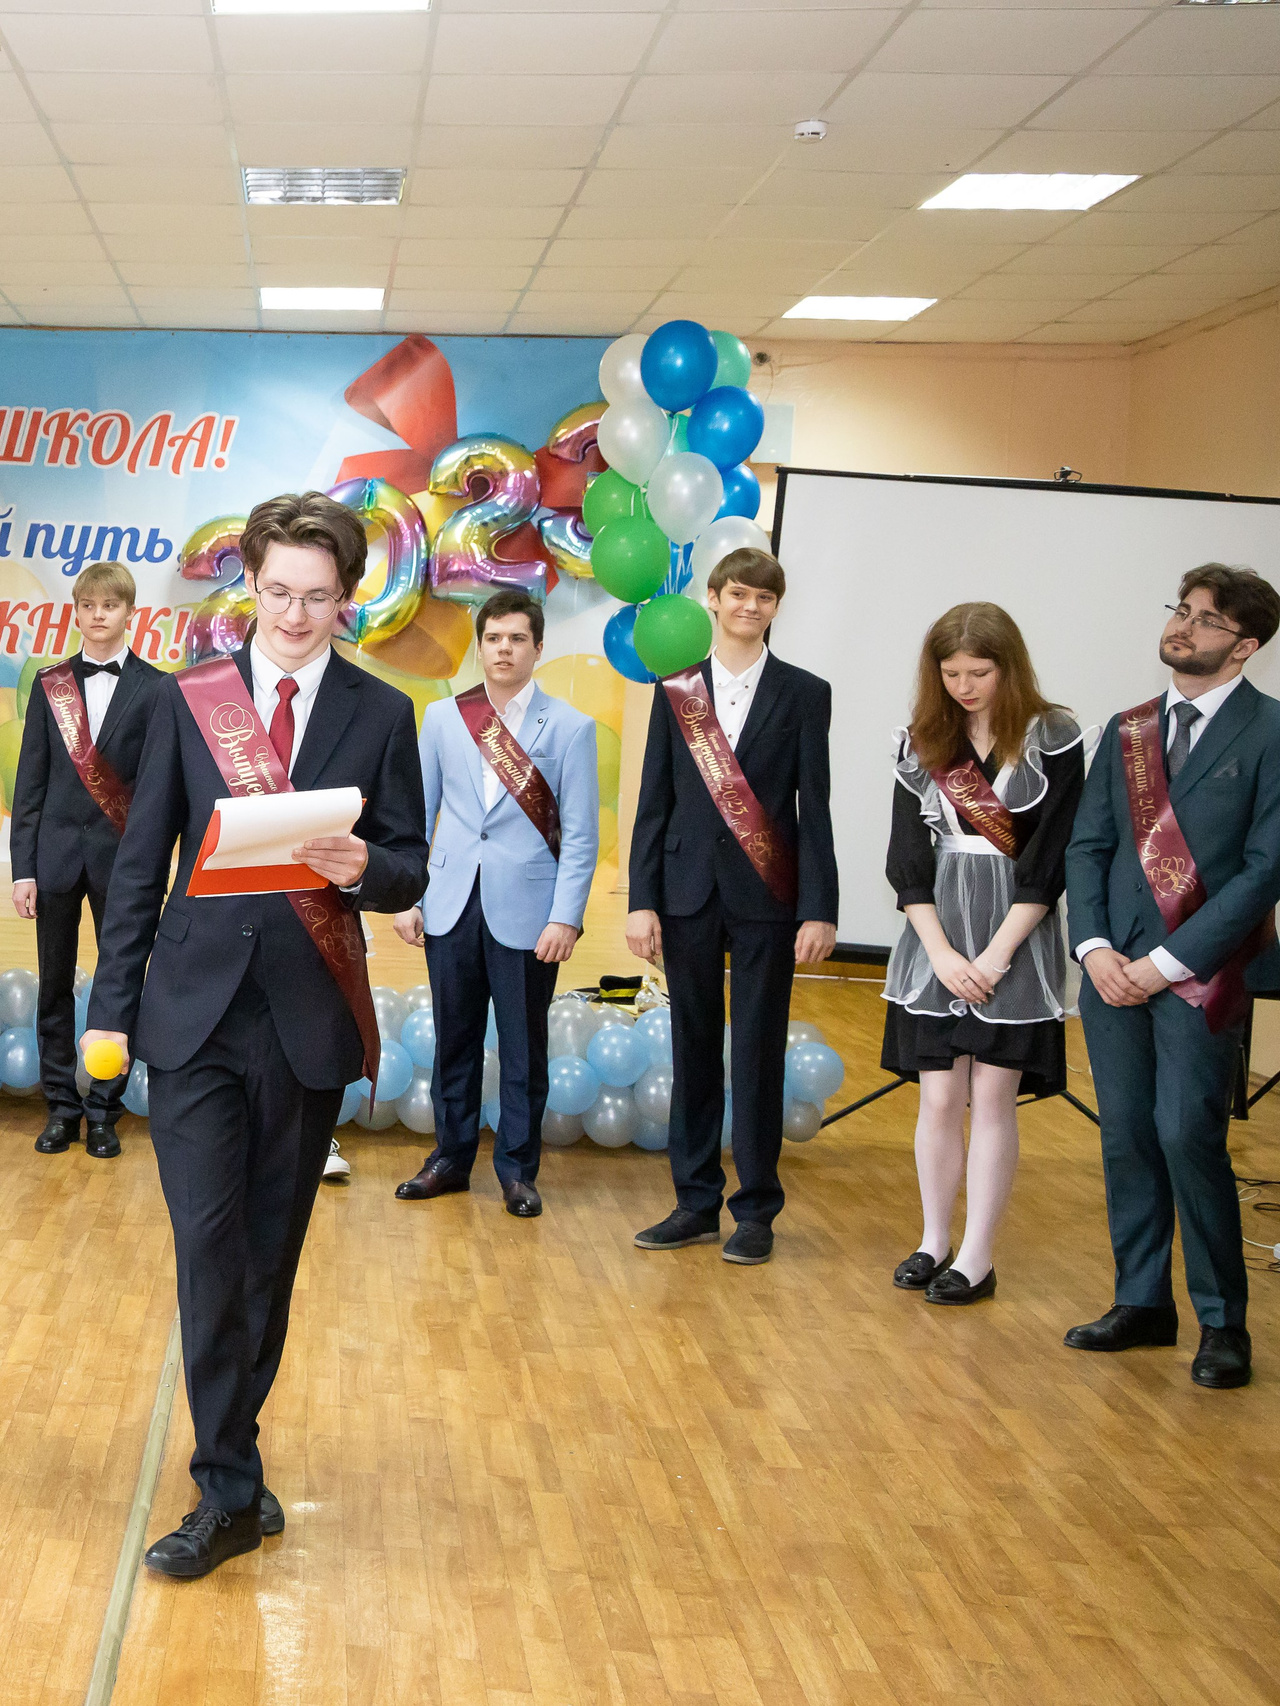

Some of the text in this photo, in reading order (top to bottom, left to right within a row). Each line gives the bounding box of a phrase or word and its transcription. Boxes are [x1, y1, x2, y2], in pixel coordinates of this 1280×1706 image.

[209, 702, 266, 797] Выпус
[477, 714, 531, 791] Выпускник
[680, 696, 725, 785] Выпускник
[717, 782, 748, 815] 2023
[1124, 704, 1155, 795] Выпускник
[1138, 797, 1162, 834] 2023
